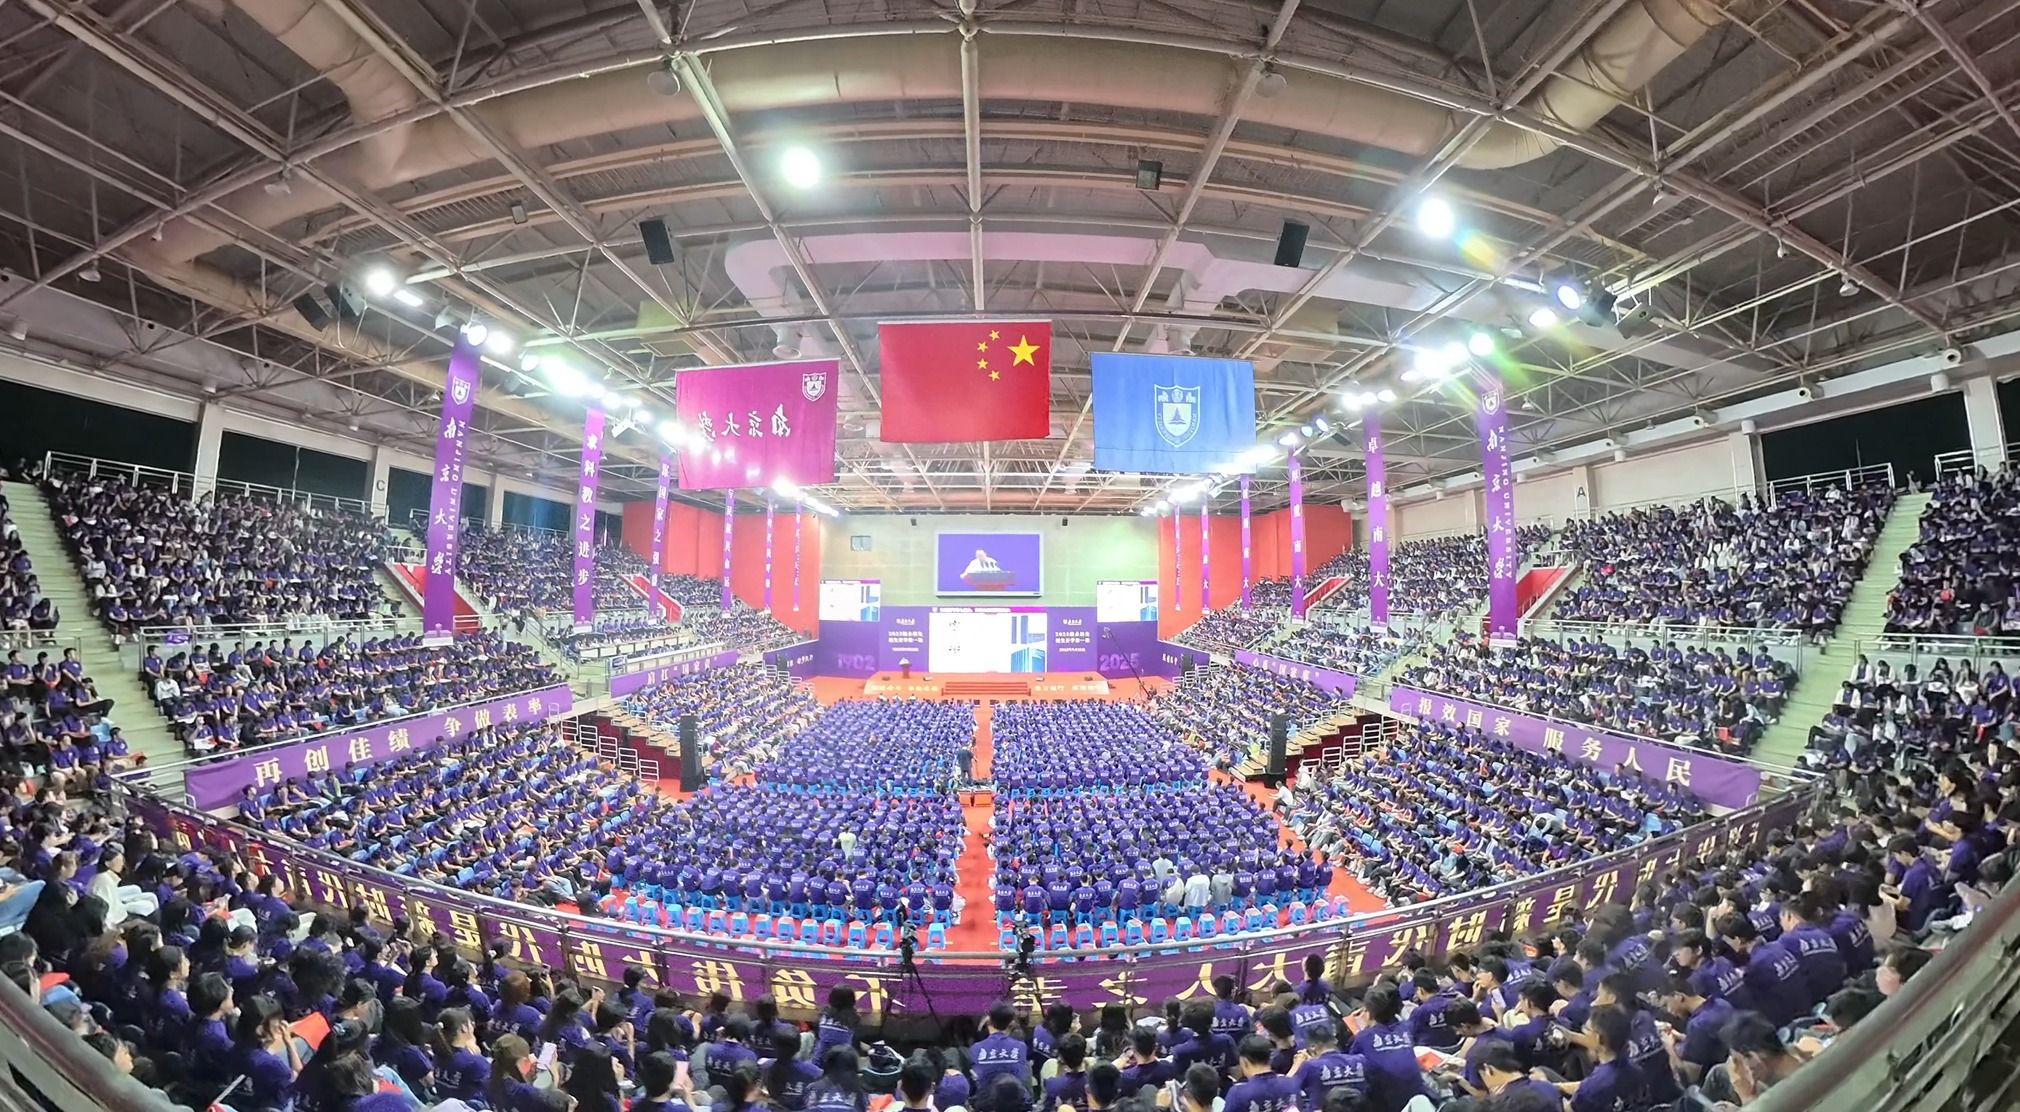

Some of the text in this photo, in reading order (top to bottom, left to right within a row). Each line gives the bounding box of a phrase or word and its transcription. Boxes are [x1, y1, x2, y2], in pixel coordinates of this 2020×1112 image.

[376, 479, 386, 492] C
[1576, 486, 1586, 498] A
[431, 417, 457, 575] 南京大学
[1487, 429, 1504, 579] 南京大学
[1368, 437, 1385, 588] 卓越南大
[838, 654, 875, 671] 1902
[1100, 653, 1140, 671] 2025
[254, 696, 541, 788] 再创佳绩 争做表率
[1418, 697, 1692, 788] 报效国家 服务人民
[978, 1046, 1020, 1062] 南京大学
[1320, 1062, 1365, 1081] 南京大学
